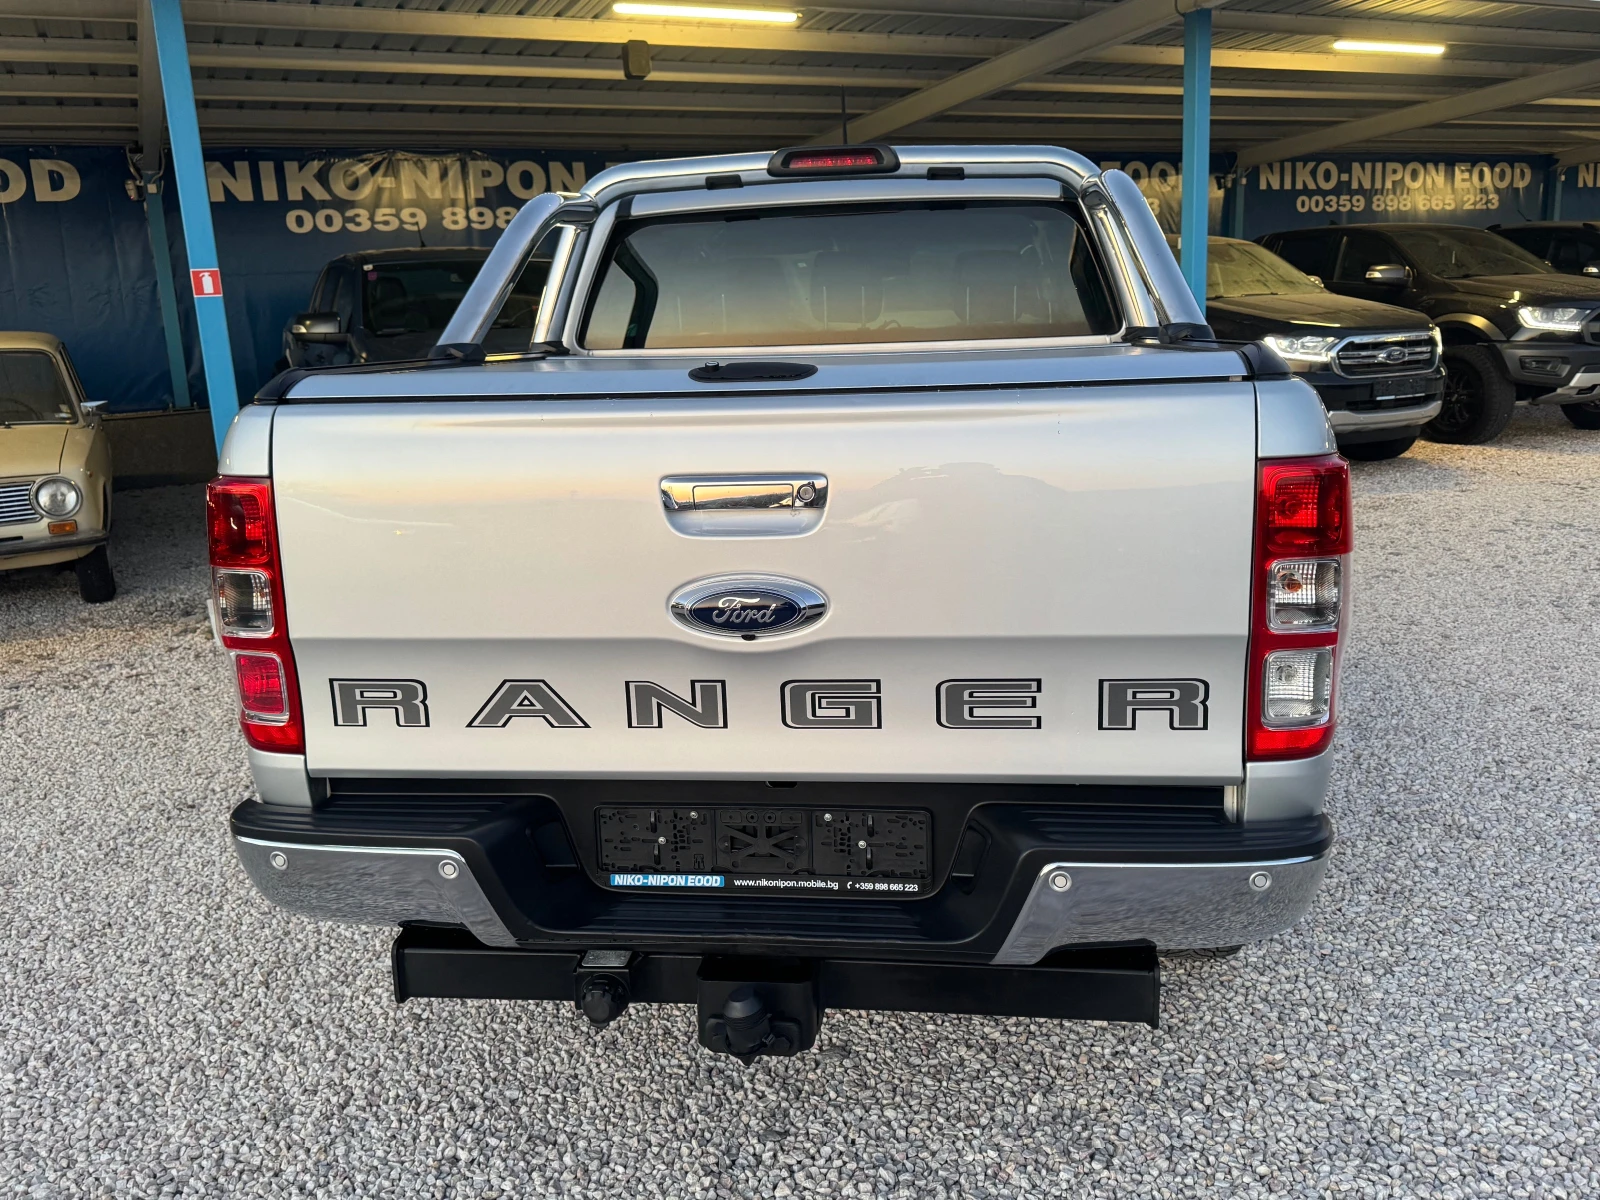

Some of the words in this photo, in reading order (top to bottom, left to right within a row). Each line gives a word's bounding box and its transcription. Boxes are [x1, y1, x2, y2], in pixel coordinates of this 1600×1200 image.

[205, 160, 587, 202] NIKO-NIPON
[1259, 161, 1445, 190] NIKO-NIPON
[1454, 161, 1532, 189] EOOD
[1296, 195, 1366, 213] 00359
[1371, 194, 1412, 212] 898
[1418, 194, 1456, 210] 665
[1462, 193, 1500, 210] 223
[286, 207, 427, 234] 00359
[712, 596, 776, 624] Ford
[329, 677, 1209, 731] RANGER
[614, 873, 686, 887] NIKO-NIPON
[687, 874, 721, 887] EOOD
[733, 878, 839, 890] www.nikonipon.mobile.bg
[855, 882, 874, 890] +359
[875, 883, 888, 891] 898
[889, 883, 904, 891] 665
[904, 884, 919, 892] 223
